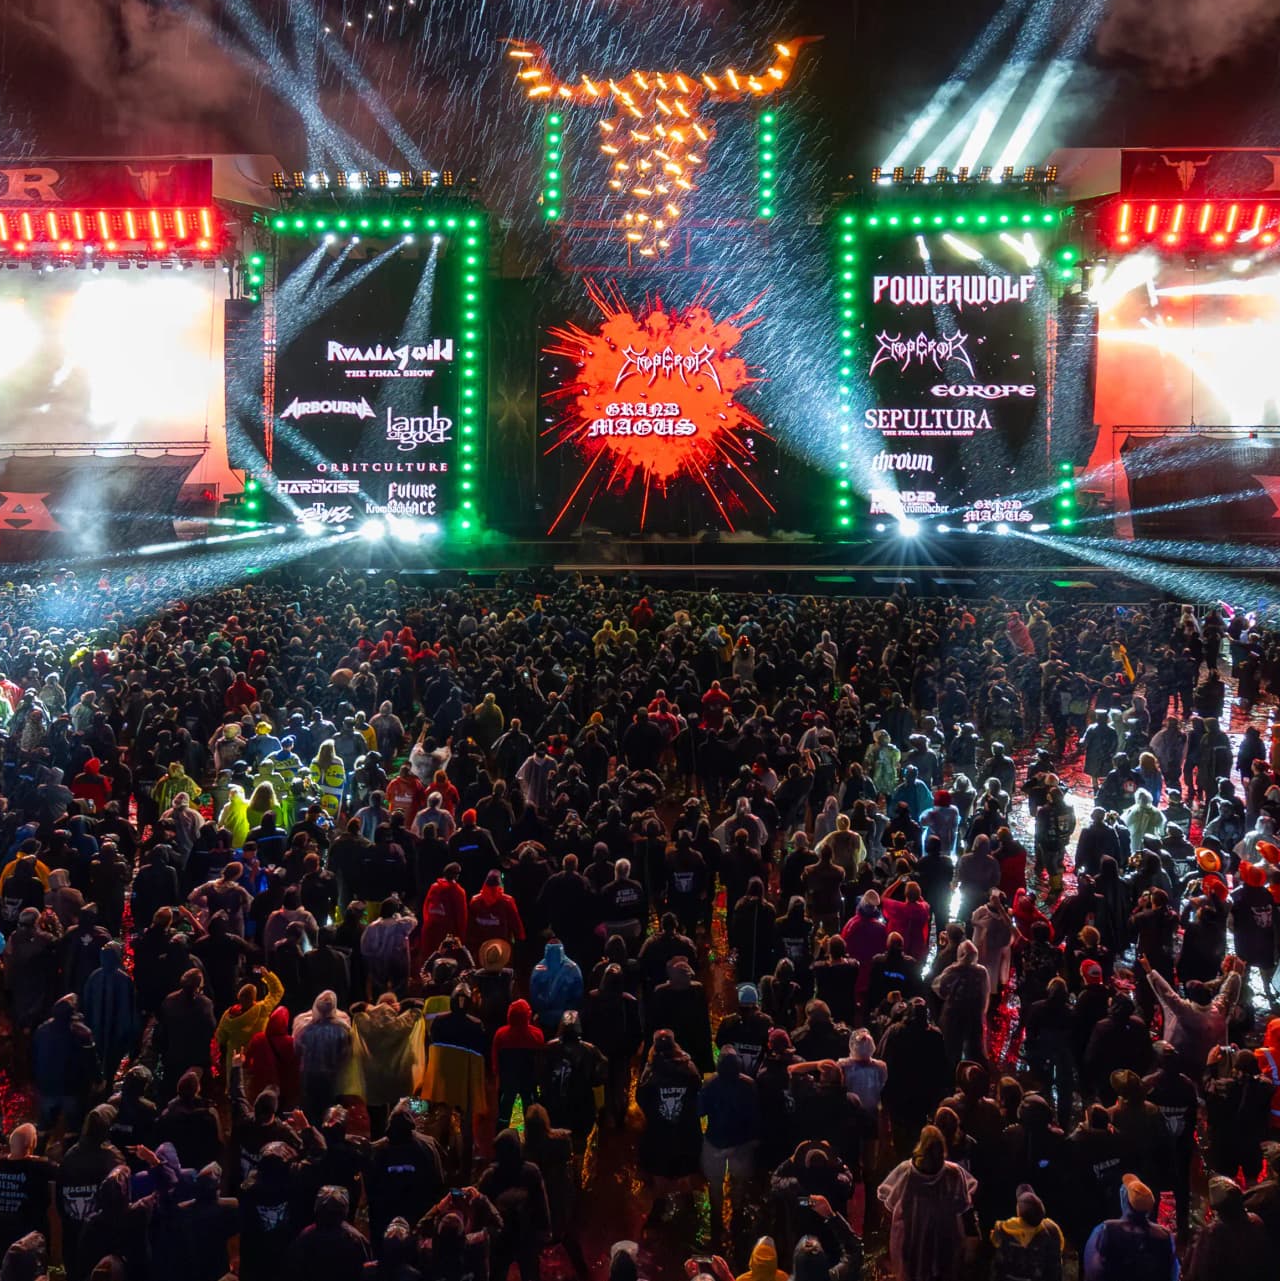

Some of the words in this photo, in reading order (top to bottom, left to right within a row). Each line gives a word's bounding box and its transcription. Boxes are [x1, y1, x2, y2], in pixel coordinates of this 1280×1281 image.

[873, 275, 1036, 313] POWERWOLF
[930, 384, 1037, 400] EUROPE
[605, 402, 680, 416] GRAND
[588, 418, 696, 437] MAGUS
[864, 408, 992, 430] SEPULTURA
[872, 450, 933, 473] thrown
[278, 483, 360, 493] HARDKISS
